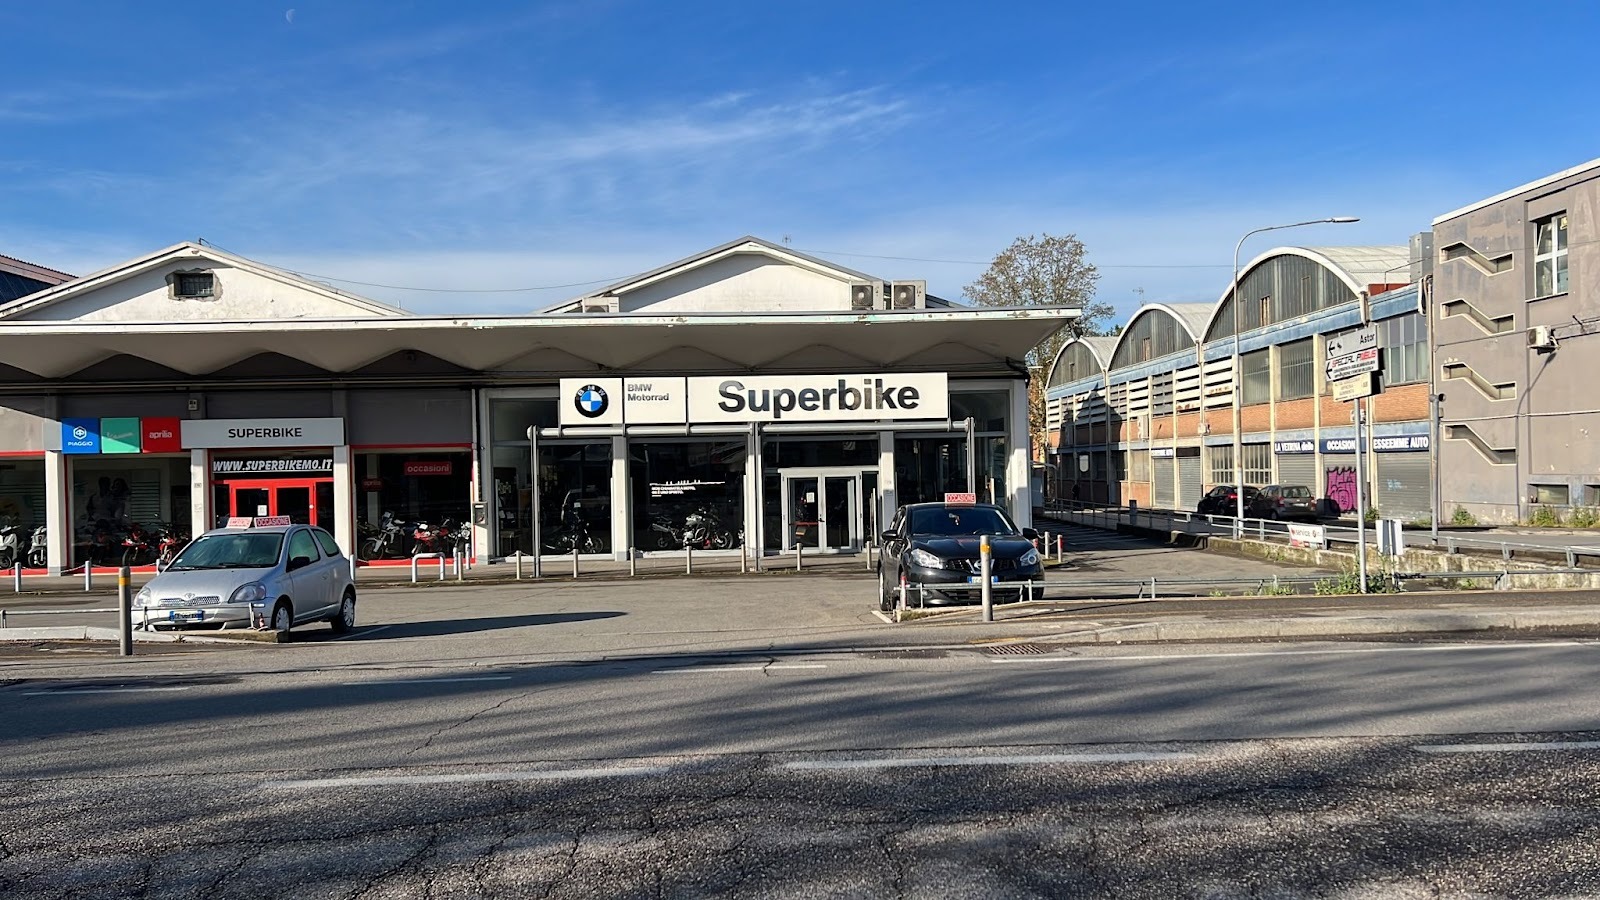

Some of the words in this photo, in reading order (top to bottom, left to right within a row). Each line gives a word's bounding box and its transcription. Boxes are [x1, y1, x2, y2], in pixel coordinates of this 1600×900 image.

[1359, 333, 1375, 344] Astor
[627, 384, 652, 392] BMW
[627, 393, 669, 401] Motorrad
[718, 379, 919, 418] Superbike
[149, 430, 172, 440] aprilia
[228, 427, 302, 438] SUPERBIKE
[1275, 441, 1281, 451] LA
[1327, 440, 1357, 450] OCCASION
[1374, 438, 1409, 449] ESSEEMME
[1410, 437, 1429, 448] AUTO
[213, 459, 333, 472] WWW.SUPERBIKEMO.IT
[407, 463, 449, 472] occasioni
[947, 494, 974, 502] OCCASIONE
[257, 516, 289, 526] OCCASIONE
